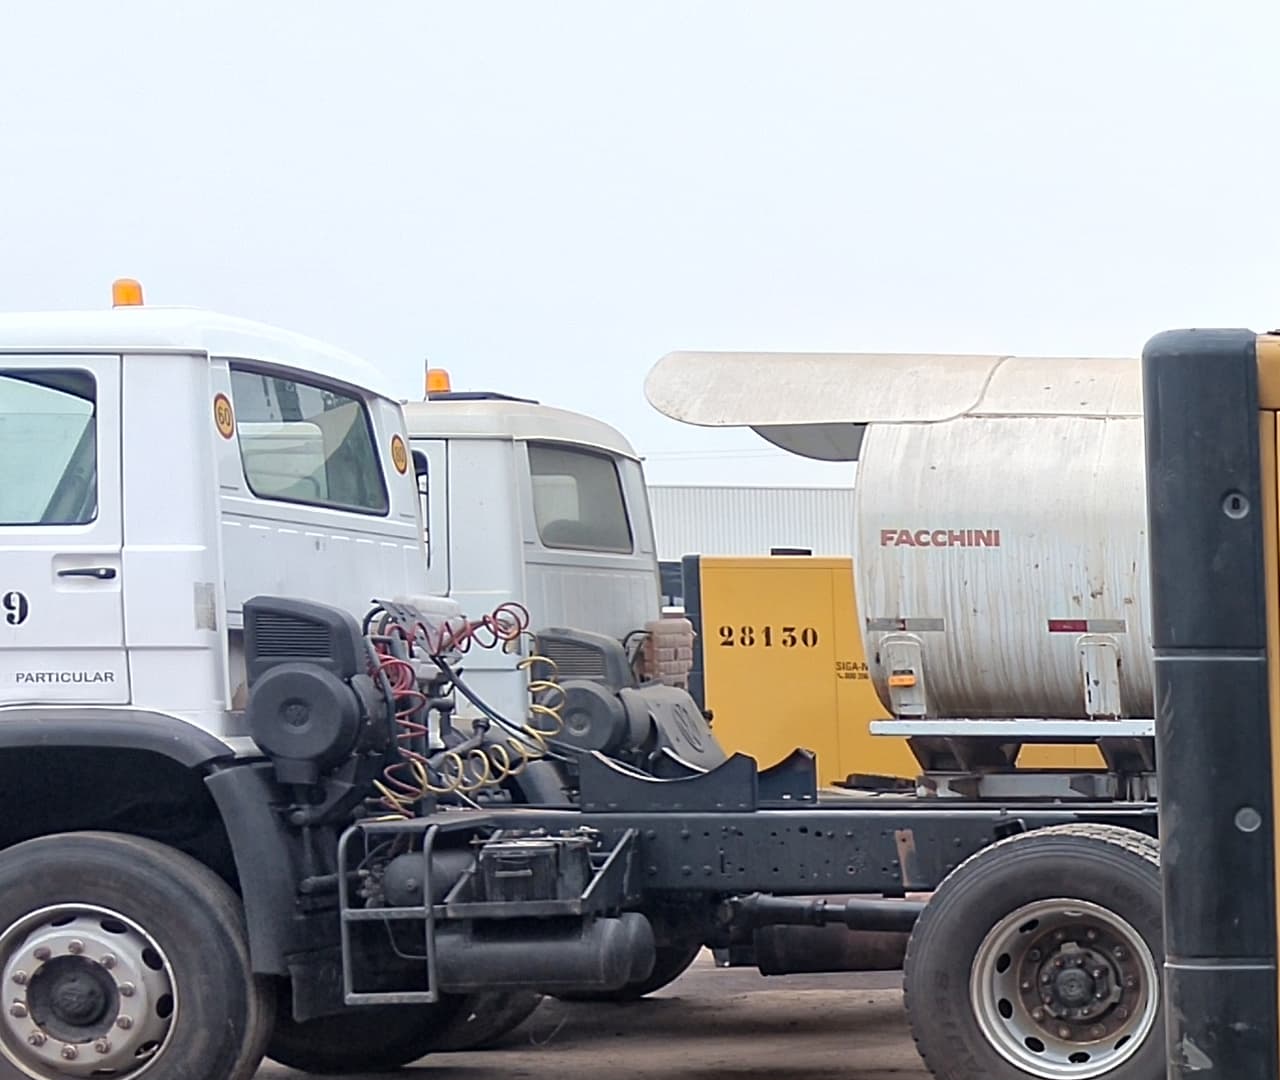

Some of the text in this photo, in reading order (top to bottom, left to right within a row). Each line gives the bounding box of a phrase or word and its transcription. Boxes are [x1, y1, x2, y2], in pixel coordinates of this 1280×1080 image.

[880, 529, 1000, 547] FACCHINI
[2, 591, 29, 625] 9
[719, 625, 819, 648] 28130
[15, 671, 115, 684] PARTICULAR
